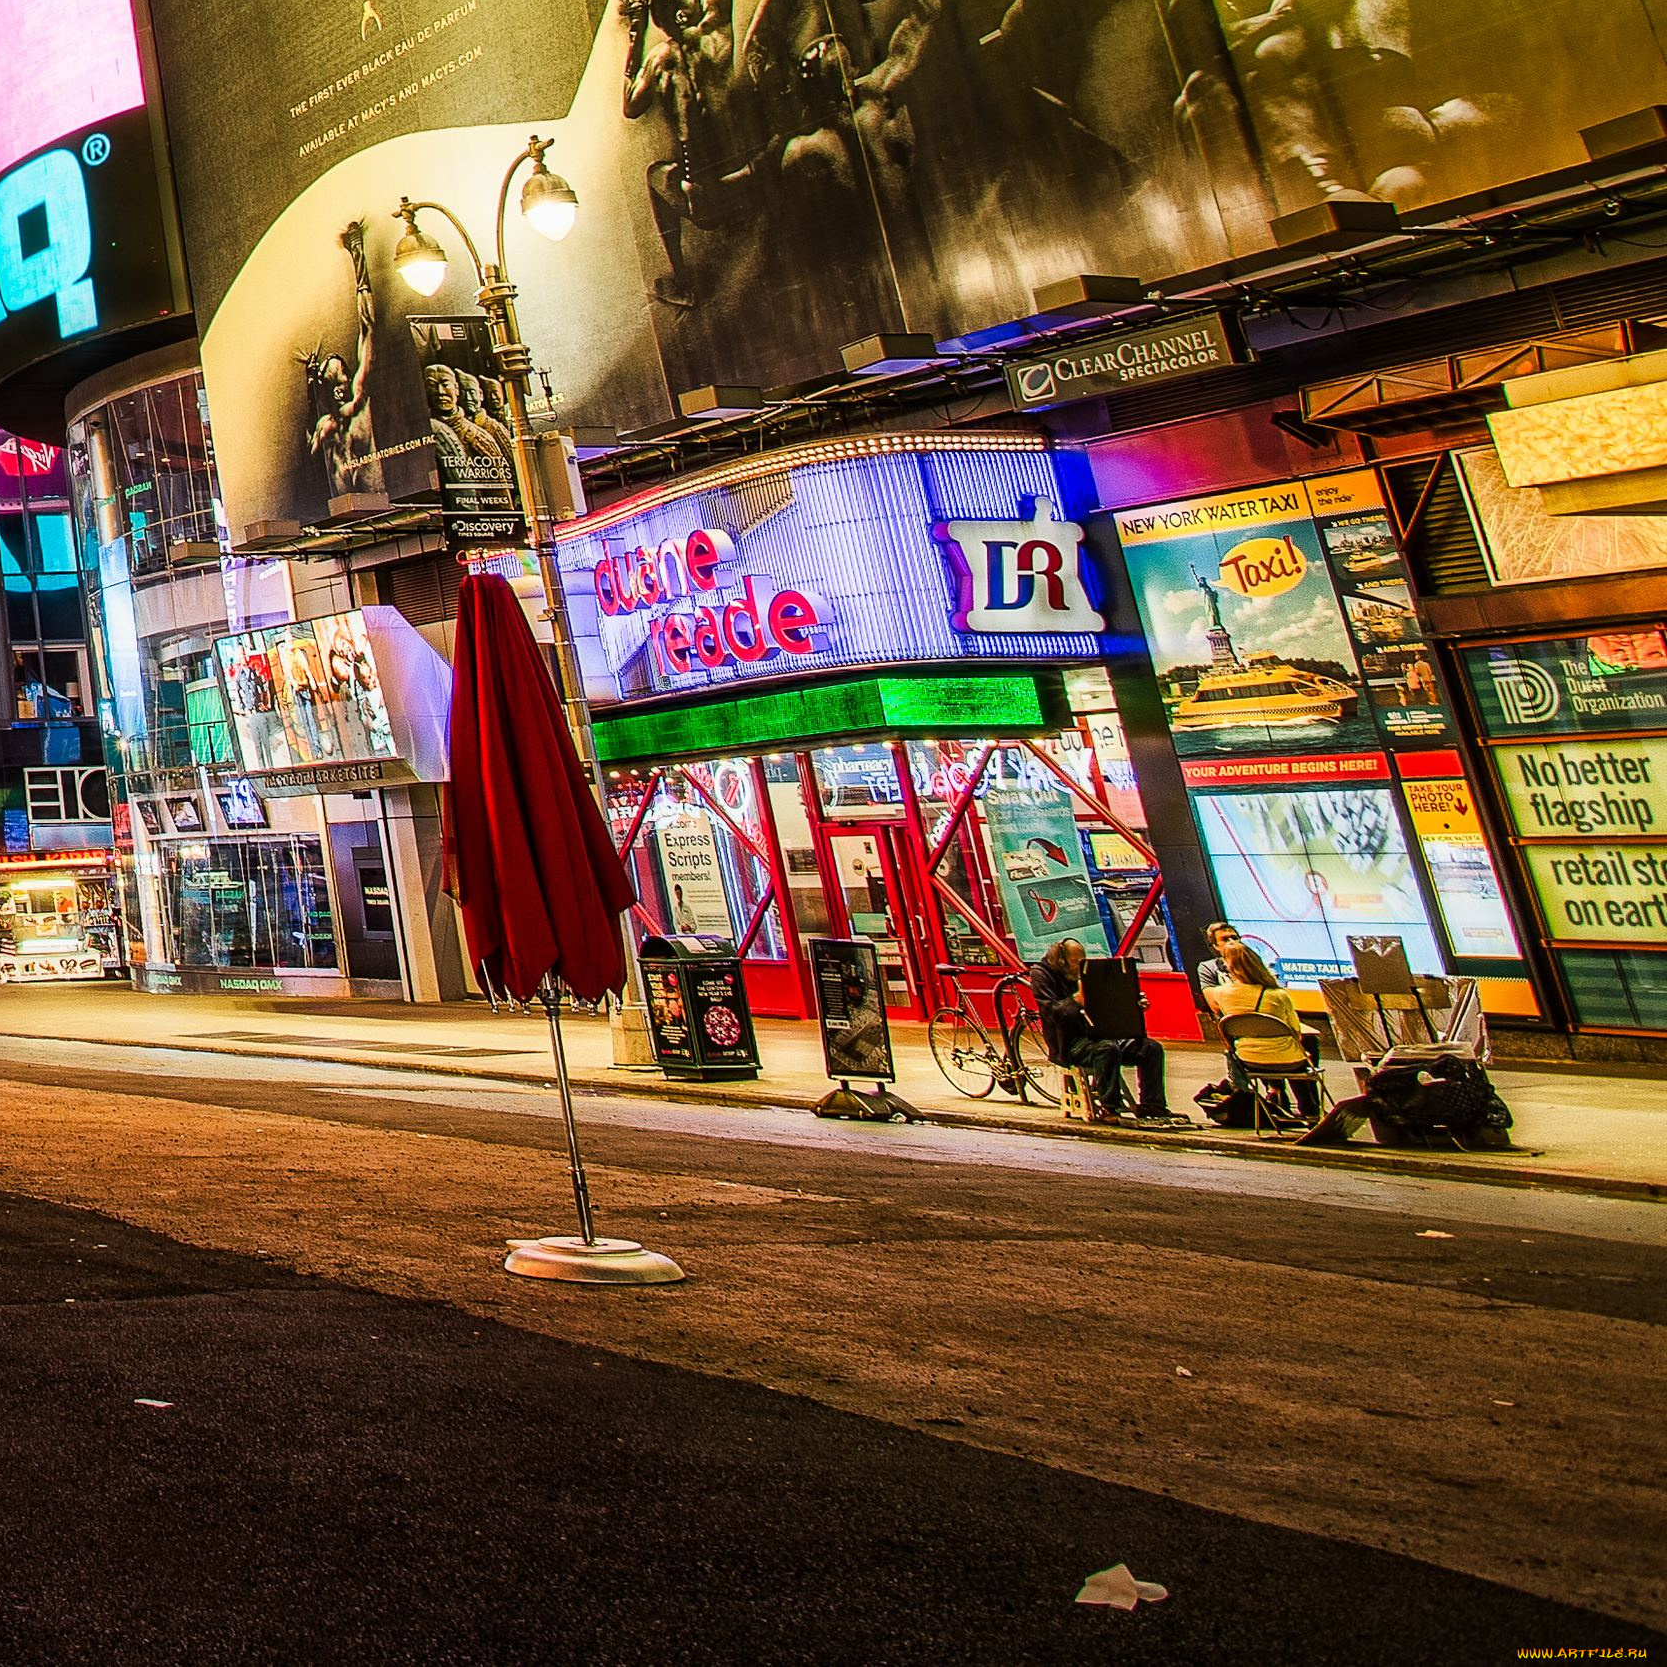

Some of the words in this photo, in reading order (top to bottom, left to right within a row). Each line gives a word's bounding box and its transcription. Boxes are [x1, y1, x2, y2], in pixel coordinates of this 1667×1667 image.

[289, 93, 310, 119] THE
[311, 82, 335, 108] FIRST
[337, 69, 360, 95] EVER
[361, 50, 394, 82] BLACK
[394, 37, 415, 59] EAU
[416, 28, 431, 48] DE
[297, 124, 343, 159] AVAILABLE
[344, 115, 359, 134] AT
[398, 80, 419, 103] AND
[419, 44, 484, 91] MACYS.COM
[1119, 349, 1219, 383] SPECTACOLOR
[442, 456, 510, 469] TERRACOTTA
[456, 467, 513, 480] WARRIORS
[455, 496, 479, 505] FINAL
[480, 496, 510, 505] WEEKS
[1315, 484, 1340, 499] enjoy
[1317, 495, 1334, 507] the
[1122, 514, 1157, 538] NEW
[1158, 507, 1204, 533] YORK
[1205, 498, 1260, 526] WATER
[1260, 491, 1301, 519] TAXI
[454, 519, 515, 535] Discovery
[594, 529, 721, 616] duane
[1220, 535, 1304, 597] Taxi!
[650, 575, 819, 675] reade
[1560, 660, 1584, 678] The
[1567, 675, 1610, 694] Durst
[1572, 692, 1665, 713] Organization
[1184, 764, 1216, 779] YOUR
[1217, 761, 1289, 778] ADVENTURE
[1291, 760, 1337, 775] BEGINS
[1339, 758, 1379, 774] HERE!
[1518, 753, 1561, 787] No
[1564, 752, 1652, 786] better
[1407, 784, 1433, 796] TAKE
[1434, 783, 1464, 795] YOUR
[1410, 792, 1451, 805] PHOTO
[1412, 801, 1451, 815] HERE!
[1530, 794, 1653, 834] flagship
[665, 833, 711, 849] Express
[668, 851, 712, 869] Scripts
[1549, 850, 1630, 886] retail
[671, 871, 712, 882] members!
[1565, 900, 1603, 927] on
[1281, 962, 1316, 974] WATER
[1317, 962, 1340, 974] TAXI
[219, 979, 260, 992] NASDAQ
[260, 979, 283, 991] OMX
